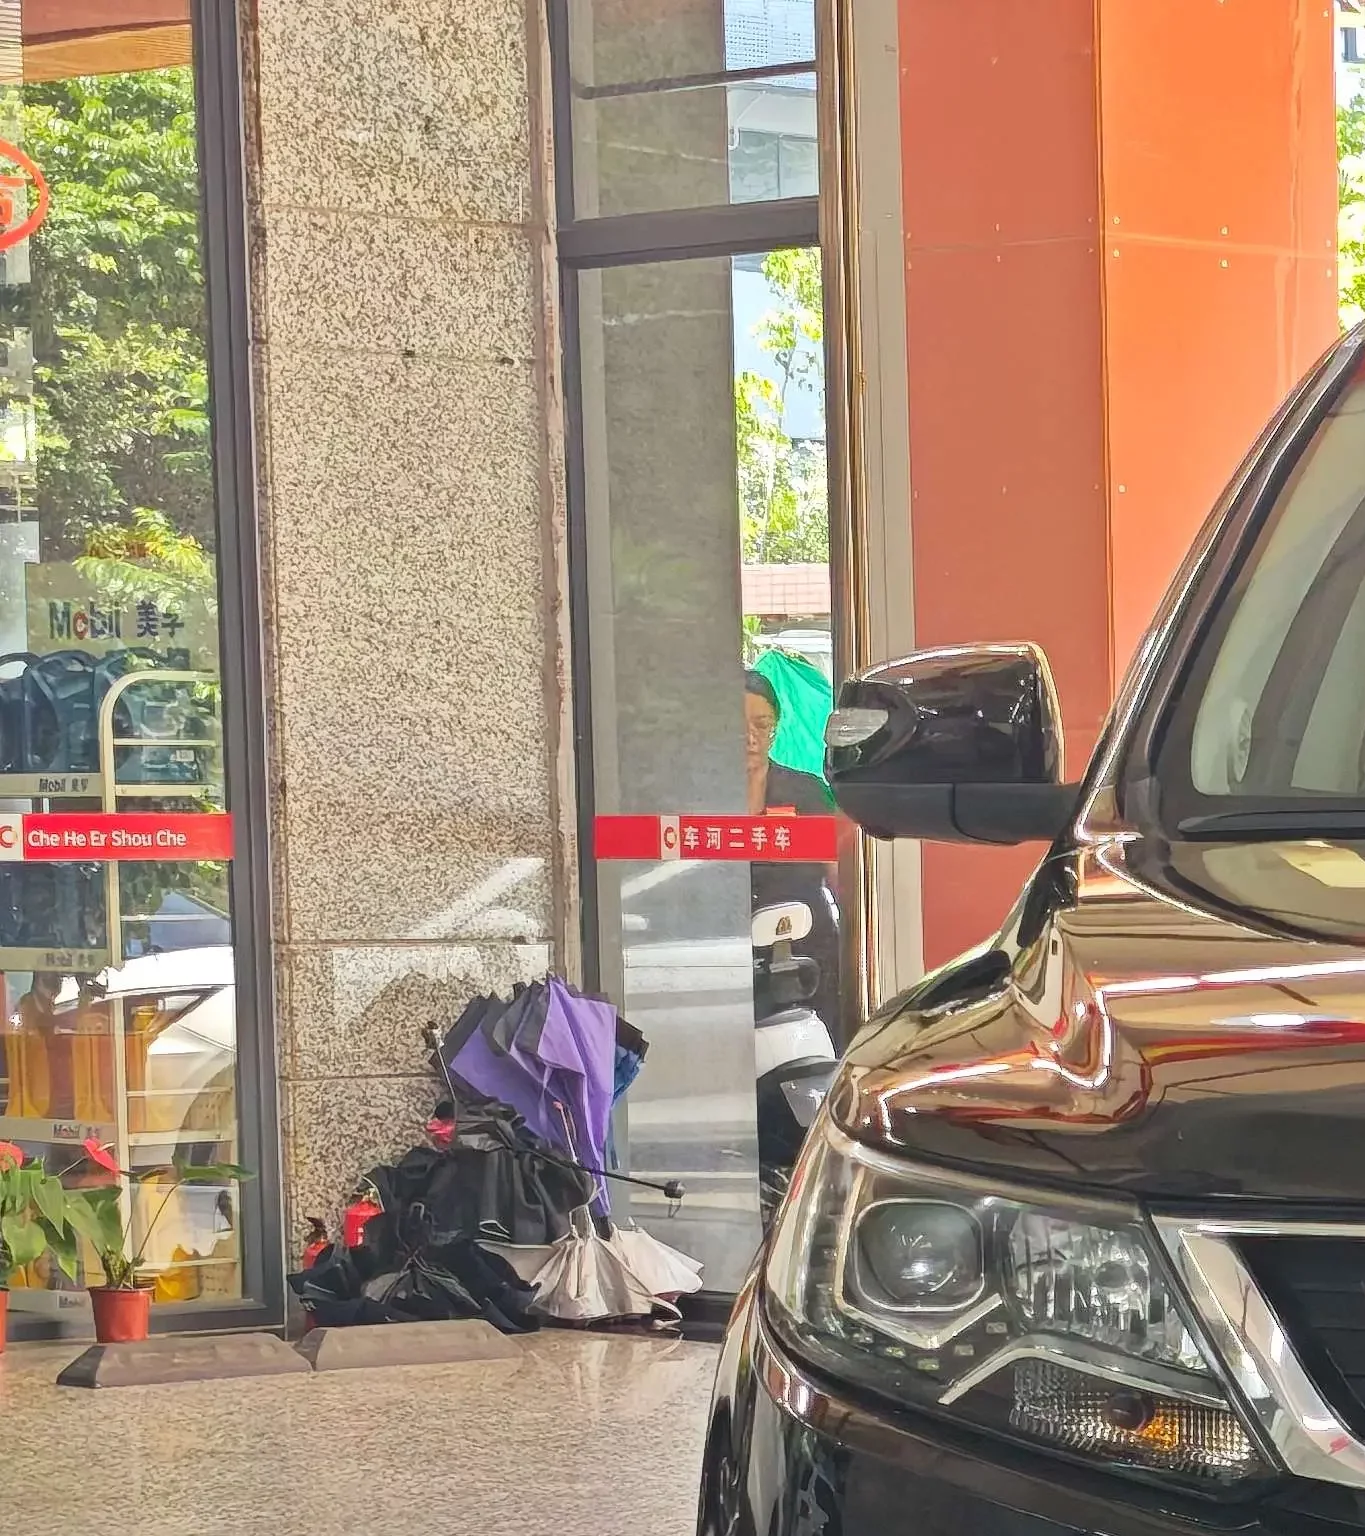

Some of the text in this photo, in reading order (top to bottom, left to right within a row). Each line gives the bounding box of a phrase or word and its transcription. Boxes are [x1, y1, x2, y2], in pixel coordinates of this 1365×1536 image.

[28, 830, 60, 847] Che
[63, 830, 87, 847] He
[91, 830, 107, 847] Er
[111, 829, 152, 847] Shou
[156, 829, 187, 847] Che
[683, 826, 791, 851] 车河二手车
